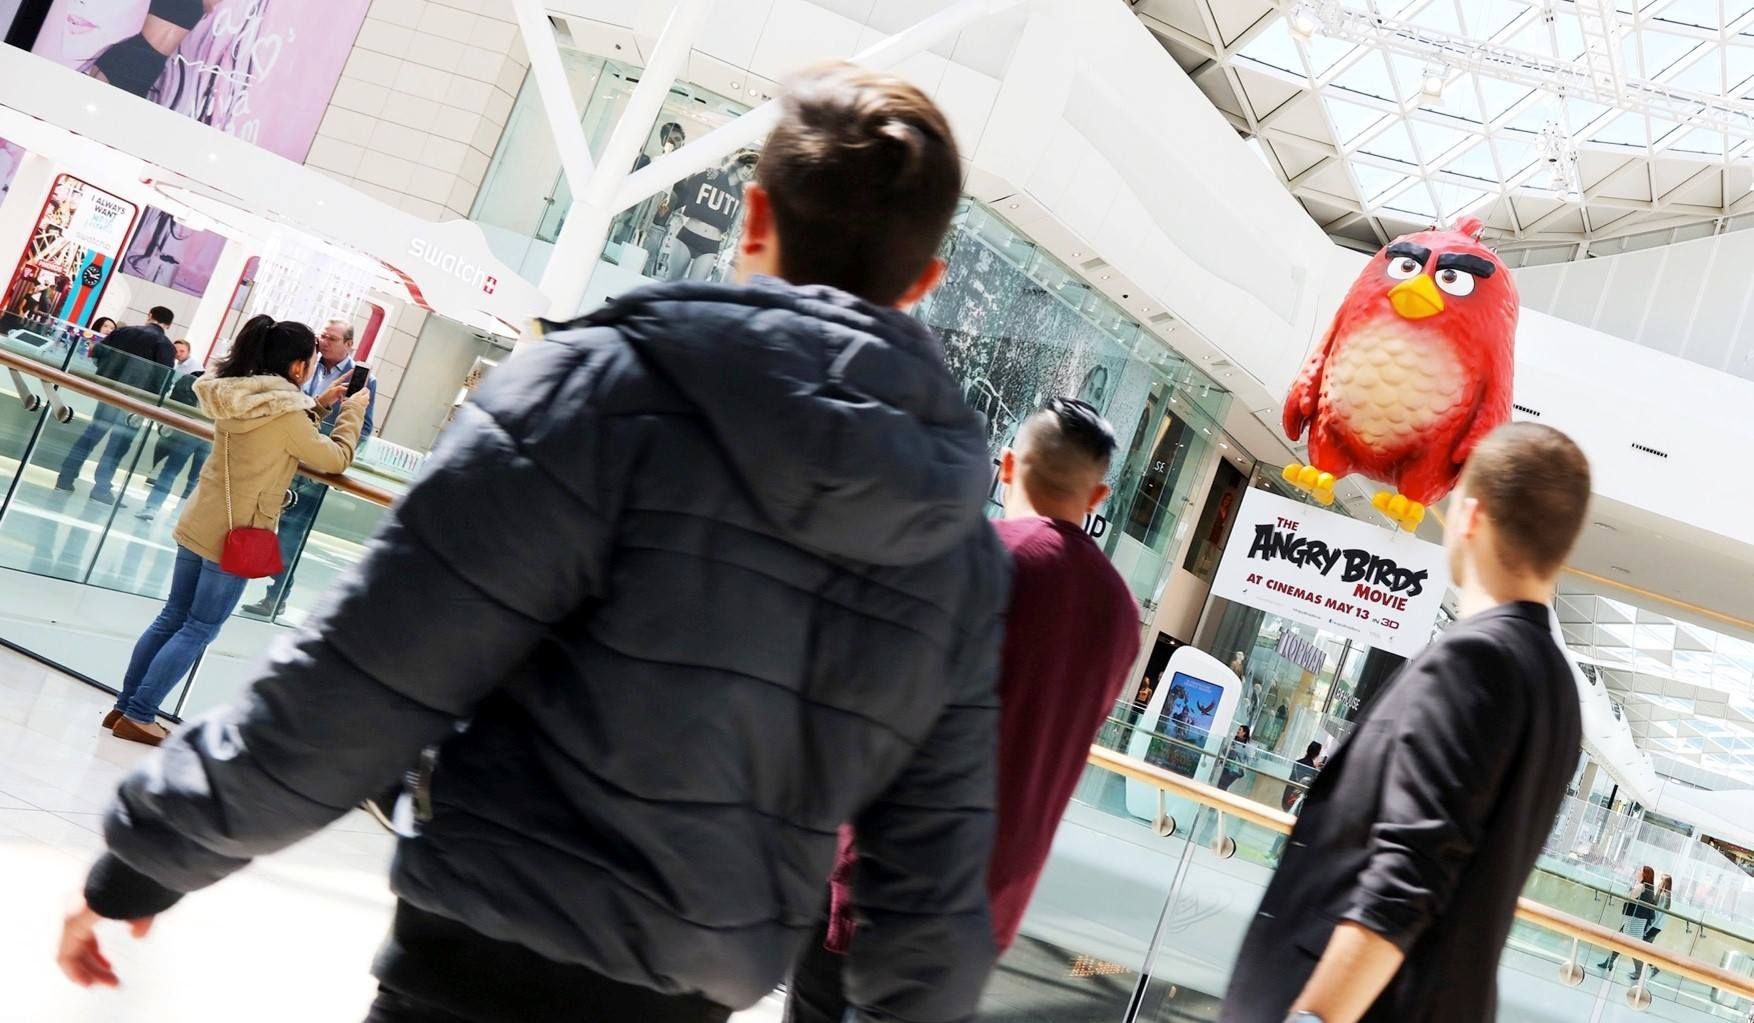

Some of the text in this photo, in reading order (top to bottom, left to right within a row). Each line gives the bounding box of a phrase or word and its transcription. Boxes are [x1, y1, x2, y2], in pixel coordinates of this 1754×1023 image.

[94, 204, 117, 219] WANT
[96, 197, 126, 215] ALWAYS
[408, 237, 485, 289] swatch
[1277, 516, 1300, 531] THE
[1247, 523, 1428, 597] ANGRY BIRDS
[1247, 573, 1264, 587] AT
[1266, 579, 1323, 605] CINEMAS
[1324, 598, 1356, 617] MAY
[1356, 607, 1370, 620] 13
[1380, 617, 1400, 630] 3D
[1353, 583, 1408, 612] MOVIE
